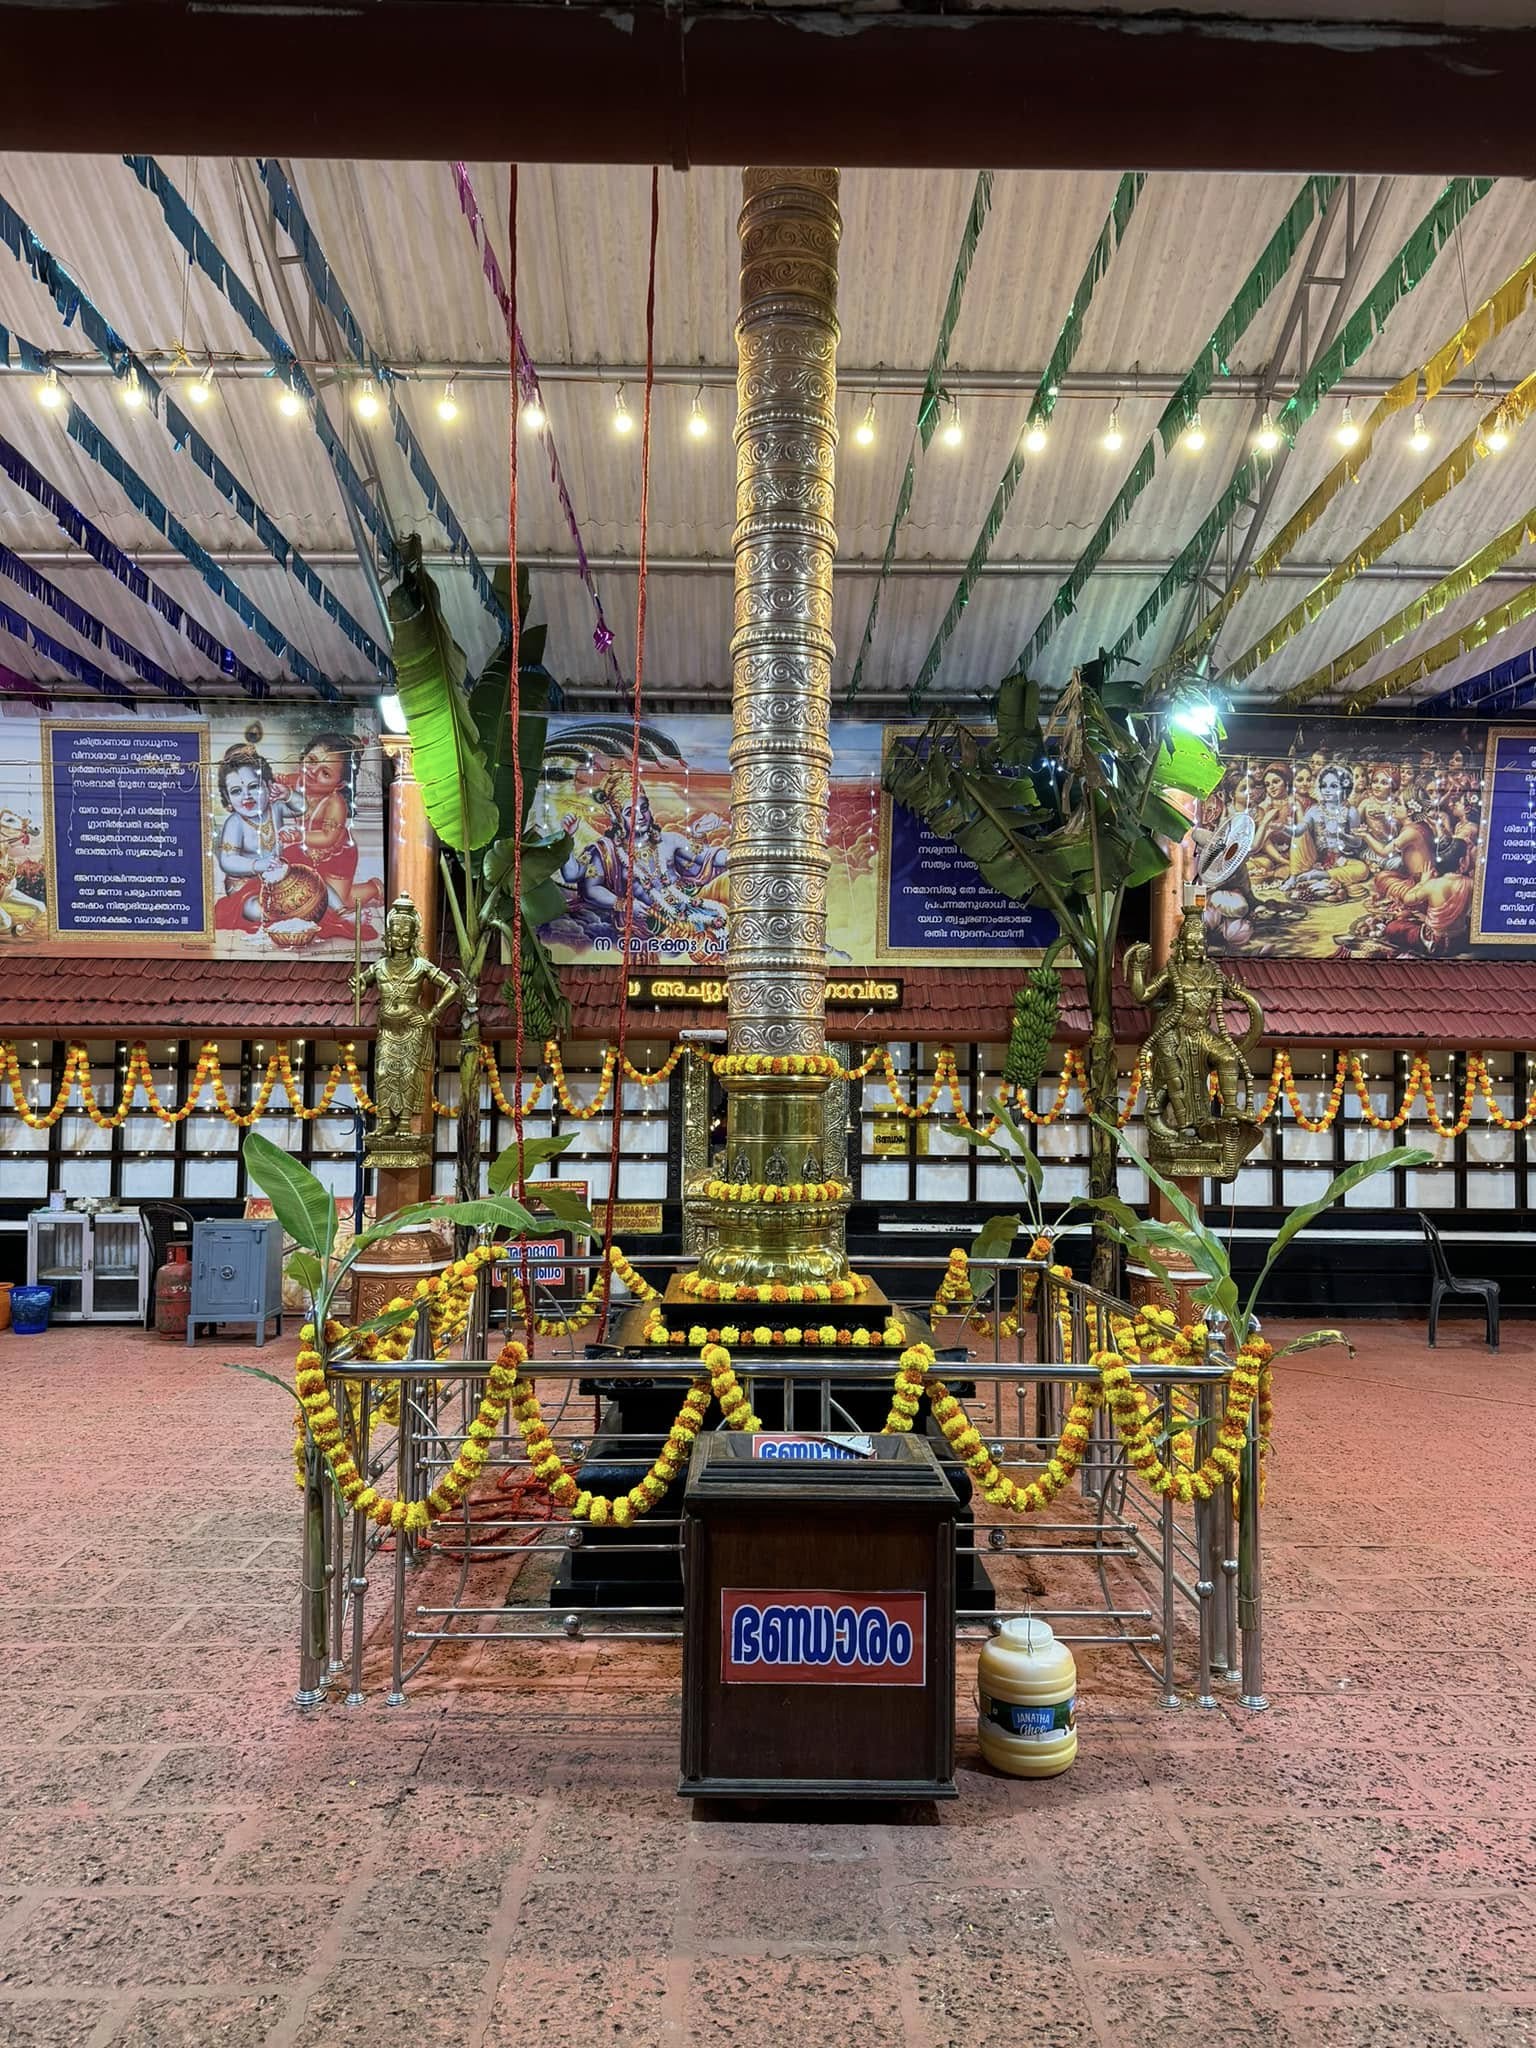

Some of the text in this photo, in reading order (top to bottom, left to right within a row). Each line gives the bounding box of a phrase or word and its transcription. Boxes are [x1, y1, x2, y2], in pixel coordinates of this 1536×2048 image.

[730, 1603, 914, 1667] ഭണ്ഡാരം
[1016, 1712, 1051, 1725] JANATHA
[1019, 1723, 1048, 1737] Ghee
